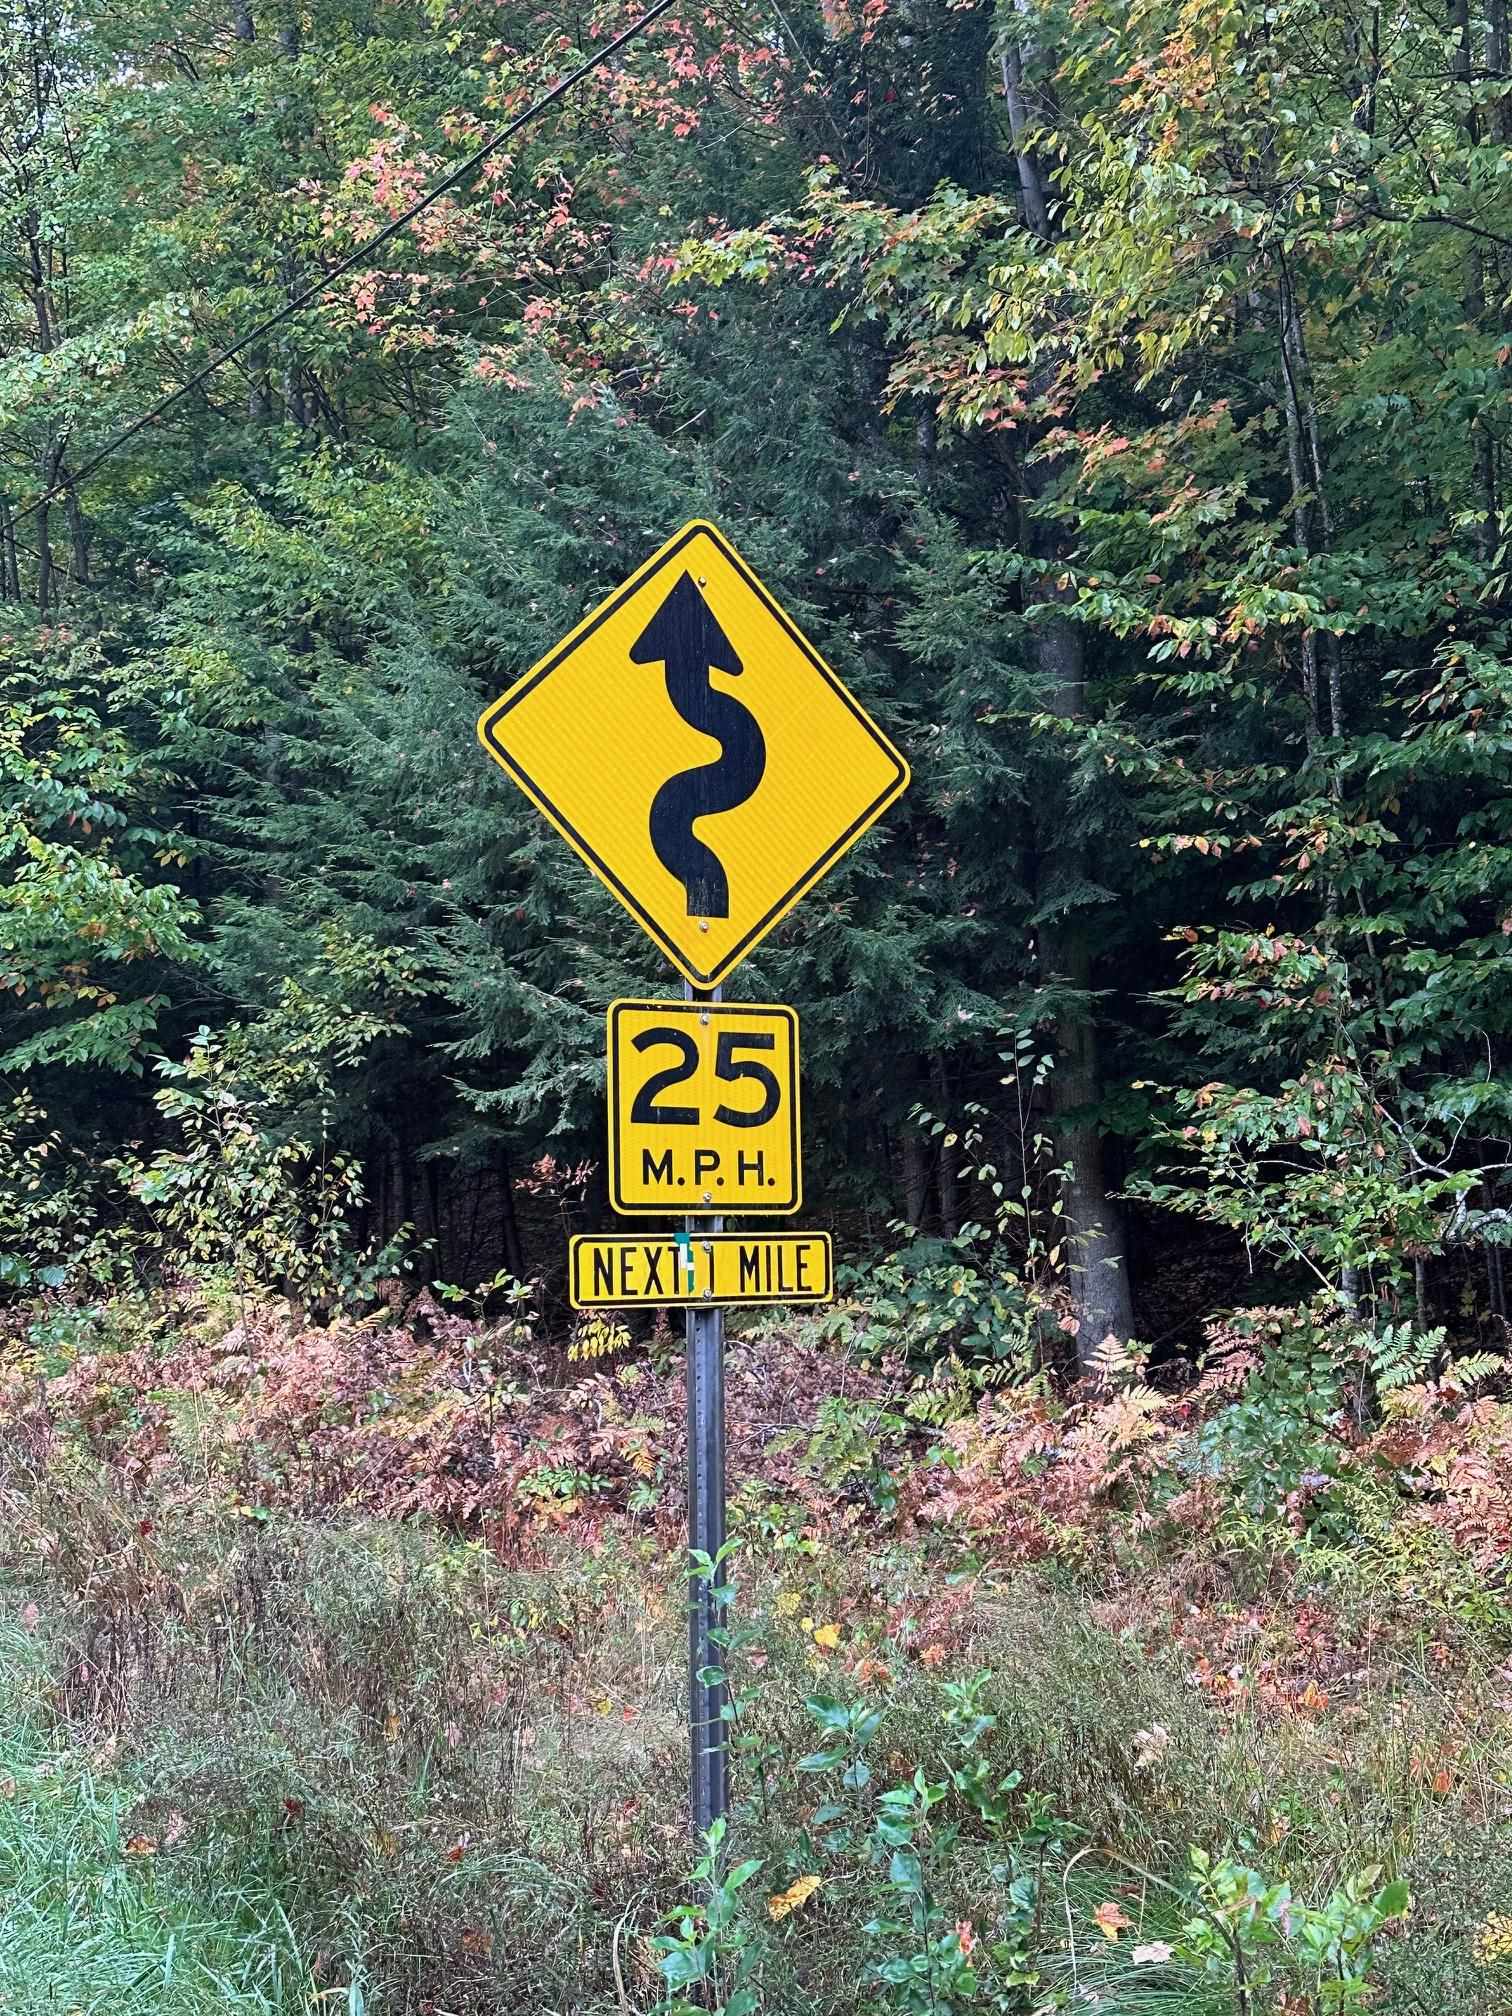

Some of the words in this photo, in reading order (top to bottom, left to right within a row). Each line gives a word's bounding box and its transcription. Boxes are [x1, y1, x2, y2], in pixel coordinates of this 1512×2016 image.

[631, 1027, 781, 1128] 25
[642, 1149, 776, 1186] M.P.H.
[593, 1246, 682, 1296] NEXT
[739, 1244, 812, 1293] MILE
